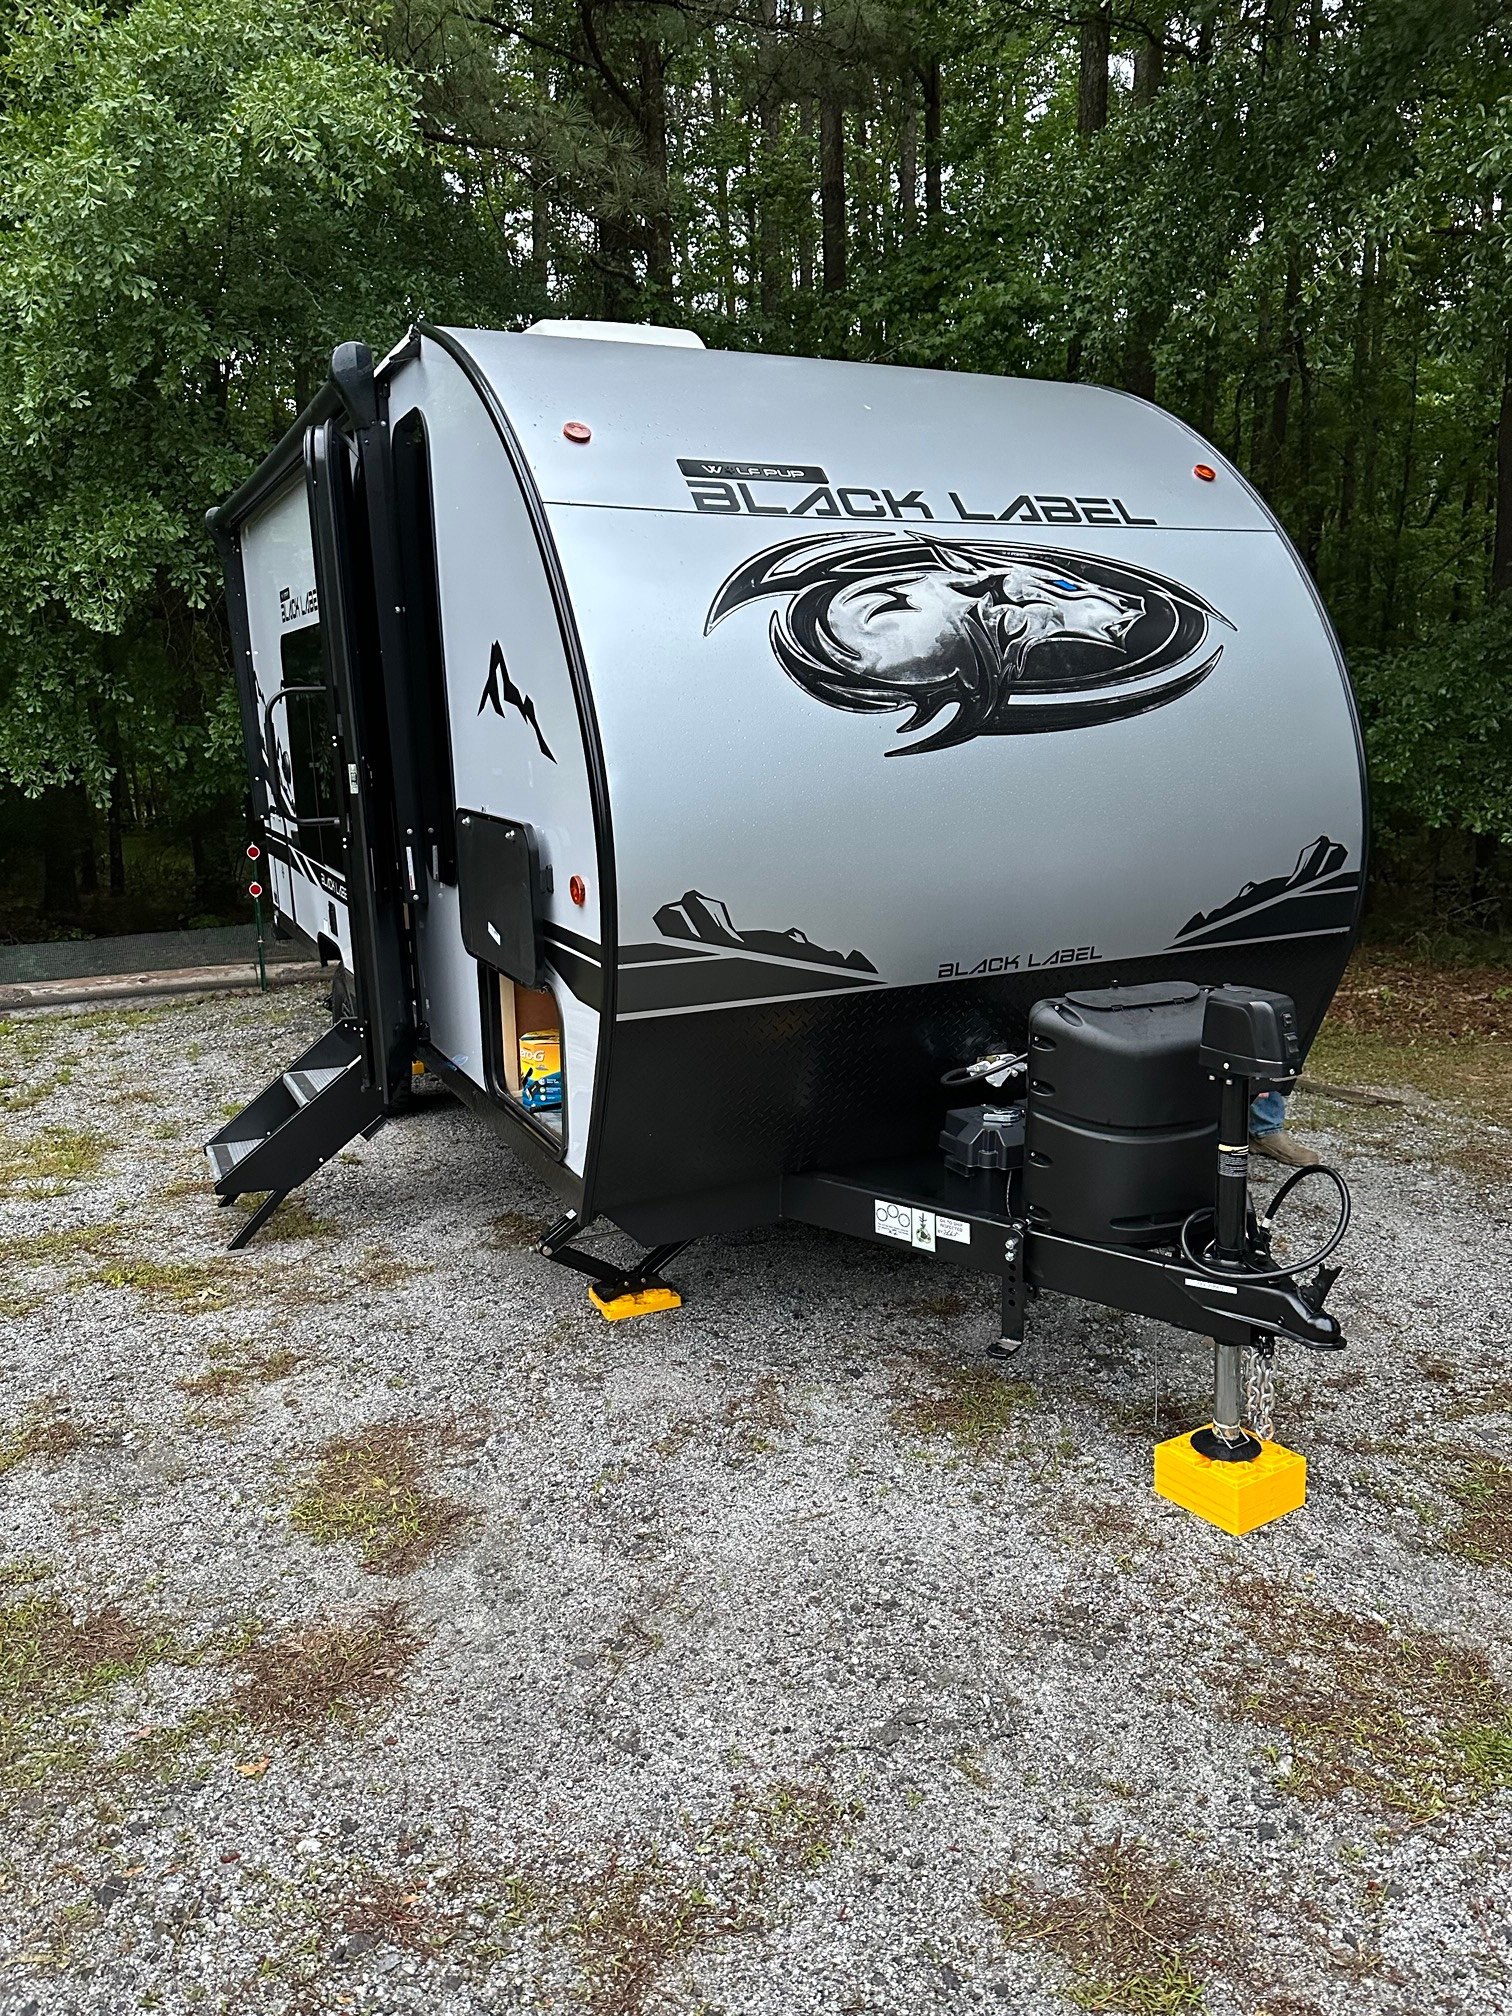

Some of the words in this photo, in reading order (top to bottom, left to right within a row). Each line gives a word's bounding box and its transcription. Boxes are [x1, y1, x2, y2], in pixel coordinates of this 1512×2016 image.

[701, 464, 761, 476] WLF
[762, 468, 805, 478] PUP
[686, 480, 935, 519] BLACK
[947, 492, 1158, 525] LABEL
[300, 589, 318, 616] LABE
[335, 882, 348, 901] LABE
[938, 954, 1021, 979] BLACK
[1027, 945, 1103, 968] LABEL
